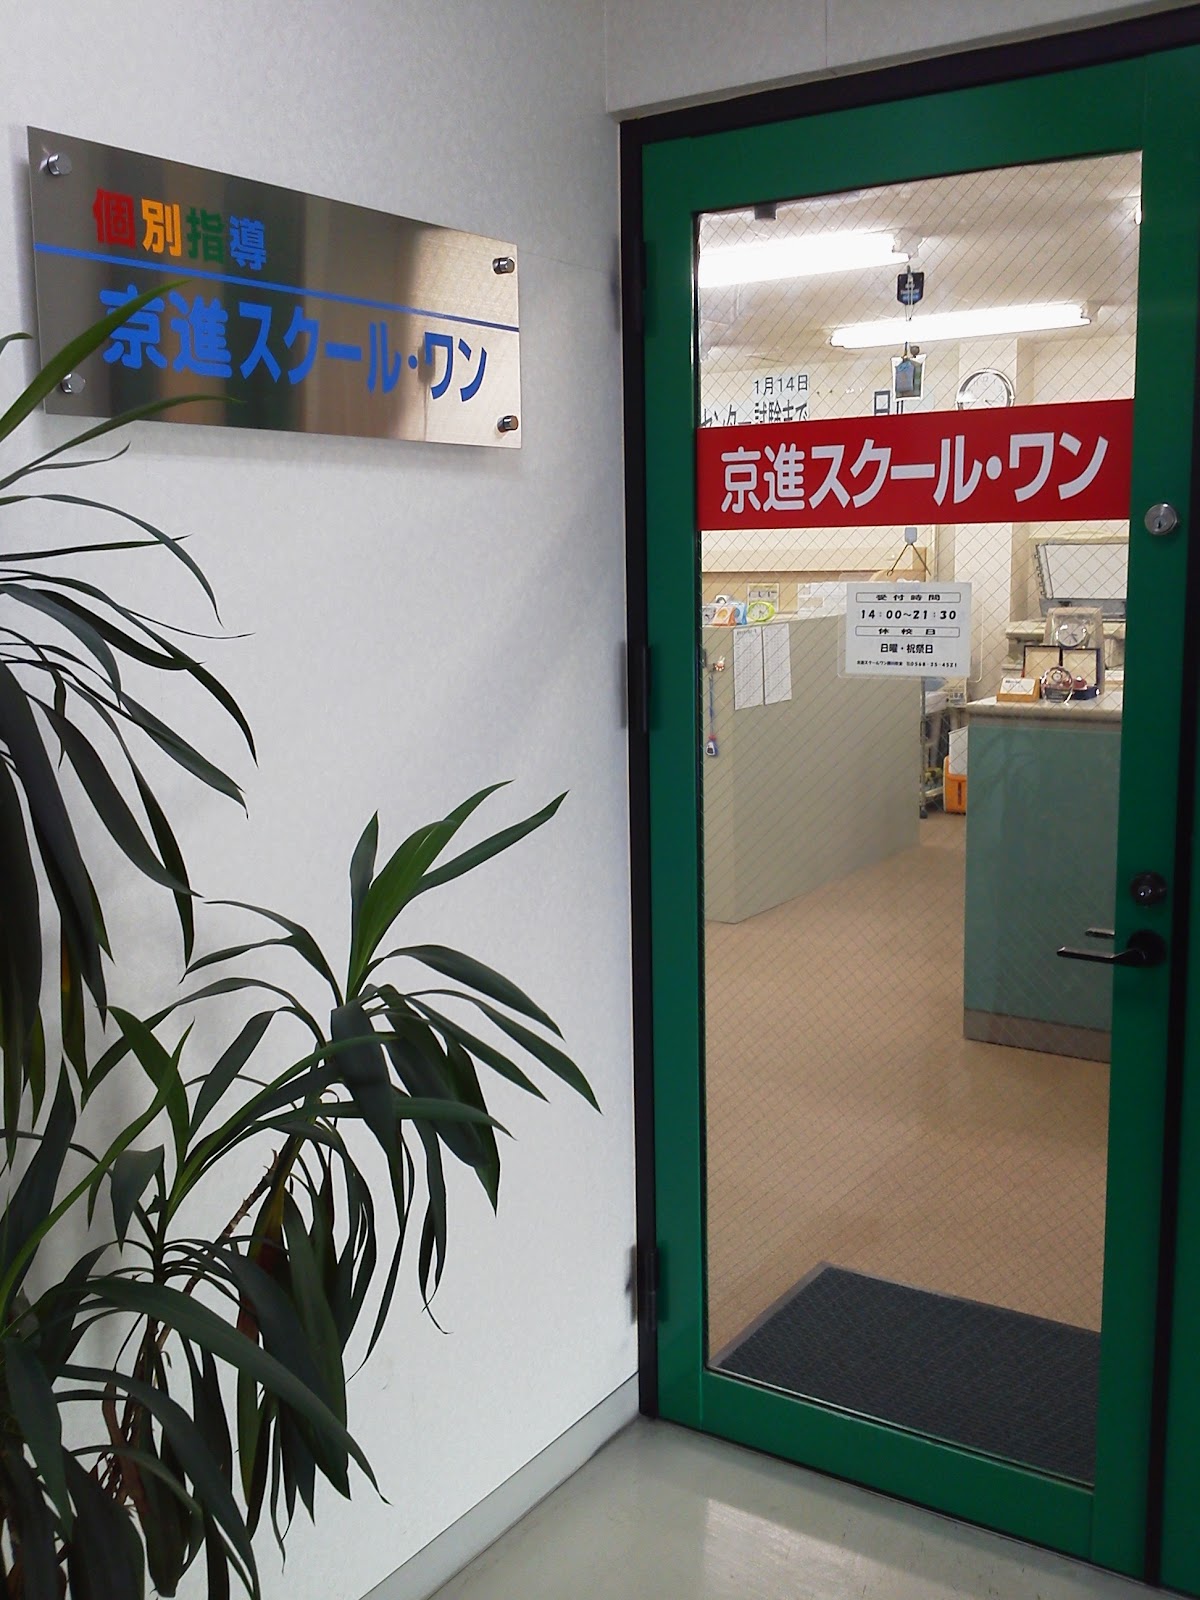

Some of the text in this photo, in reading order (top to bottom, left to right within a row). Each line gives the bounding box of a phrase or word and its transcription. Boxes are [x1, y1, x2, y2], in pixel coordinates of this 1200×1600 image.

[92, 187, 268, 271] 個別指導
[99, 284, 488, 403] 京進スクール・ワン
[753, 374, 808, 396] 1月14日
[720, 431, 1110, 514] 京進スクール・ワン
[875, 594, 941, 602] 受付時間
[878, 628, 936, 636] 休校日
[880, 643, 934, 654] 日曜・祝祭日
